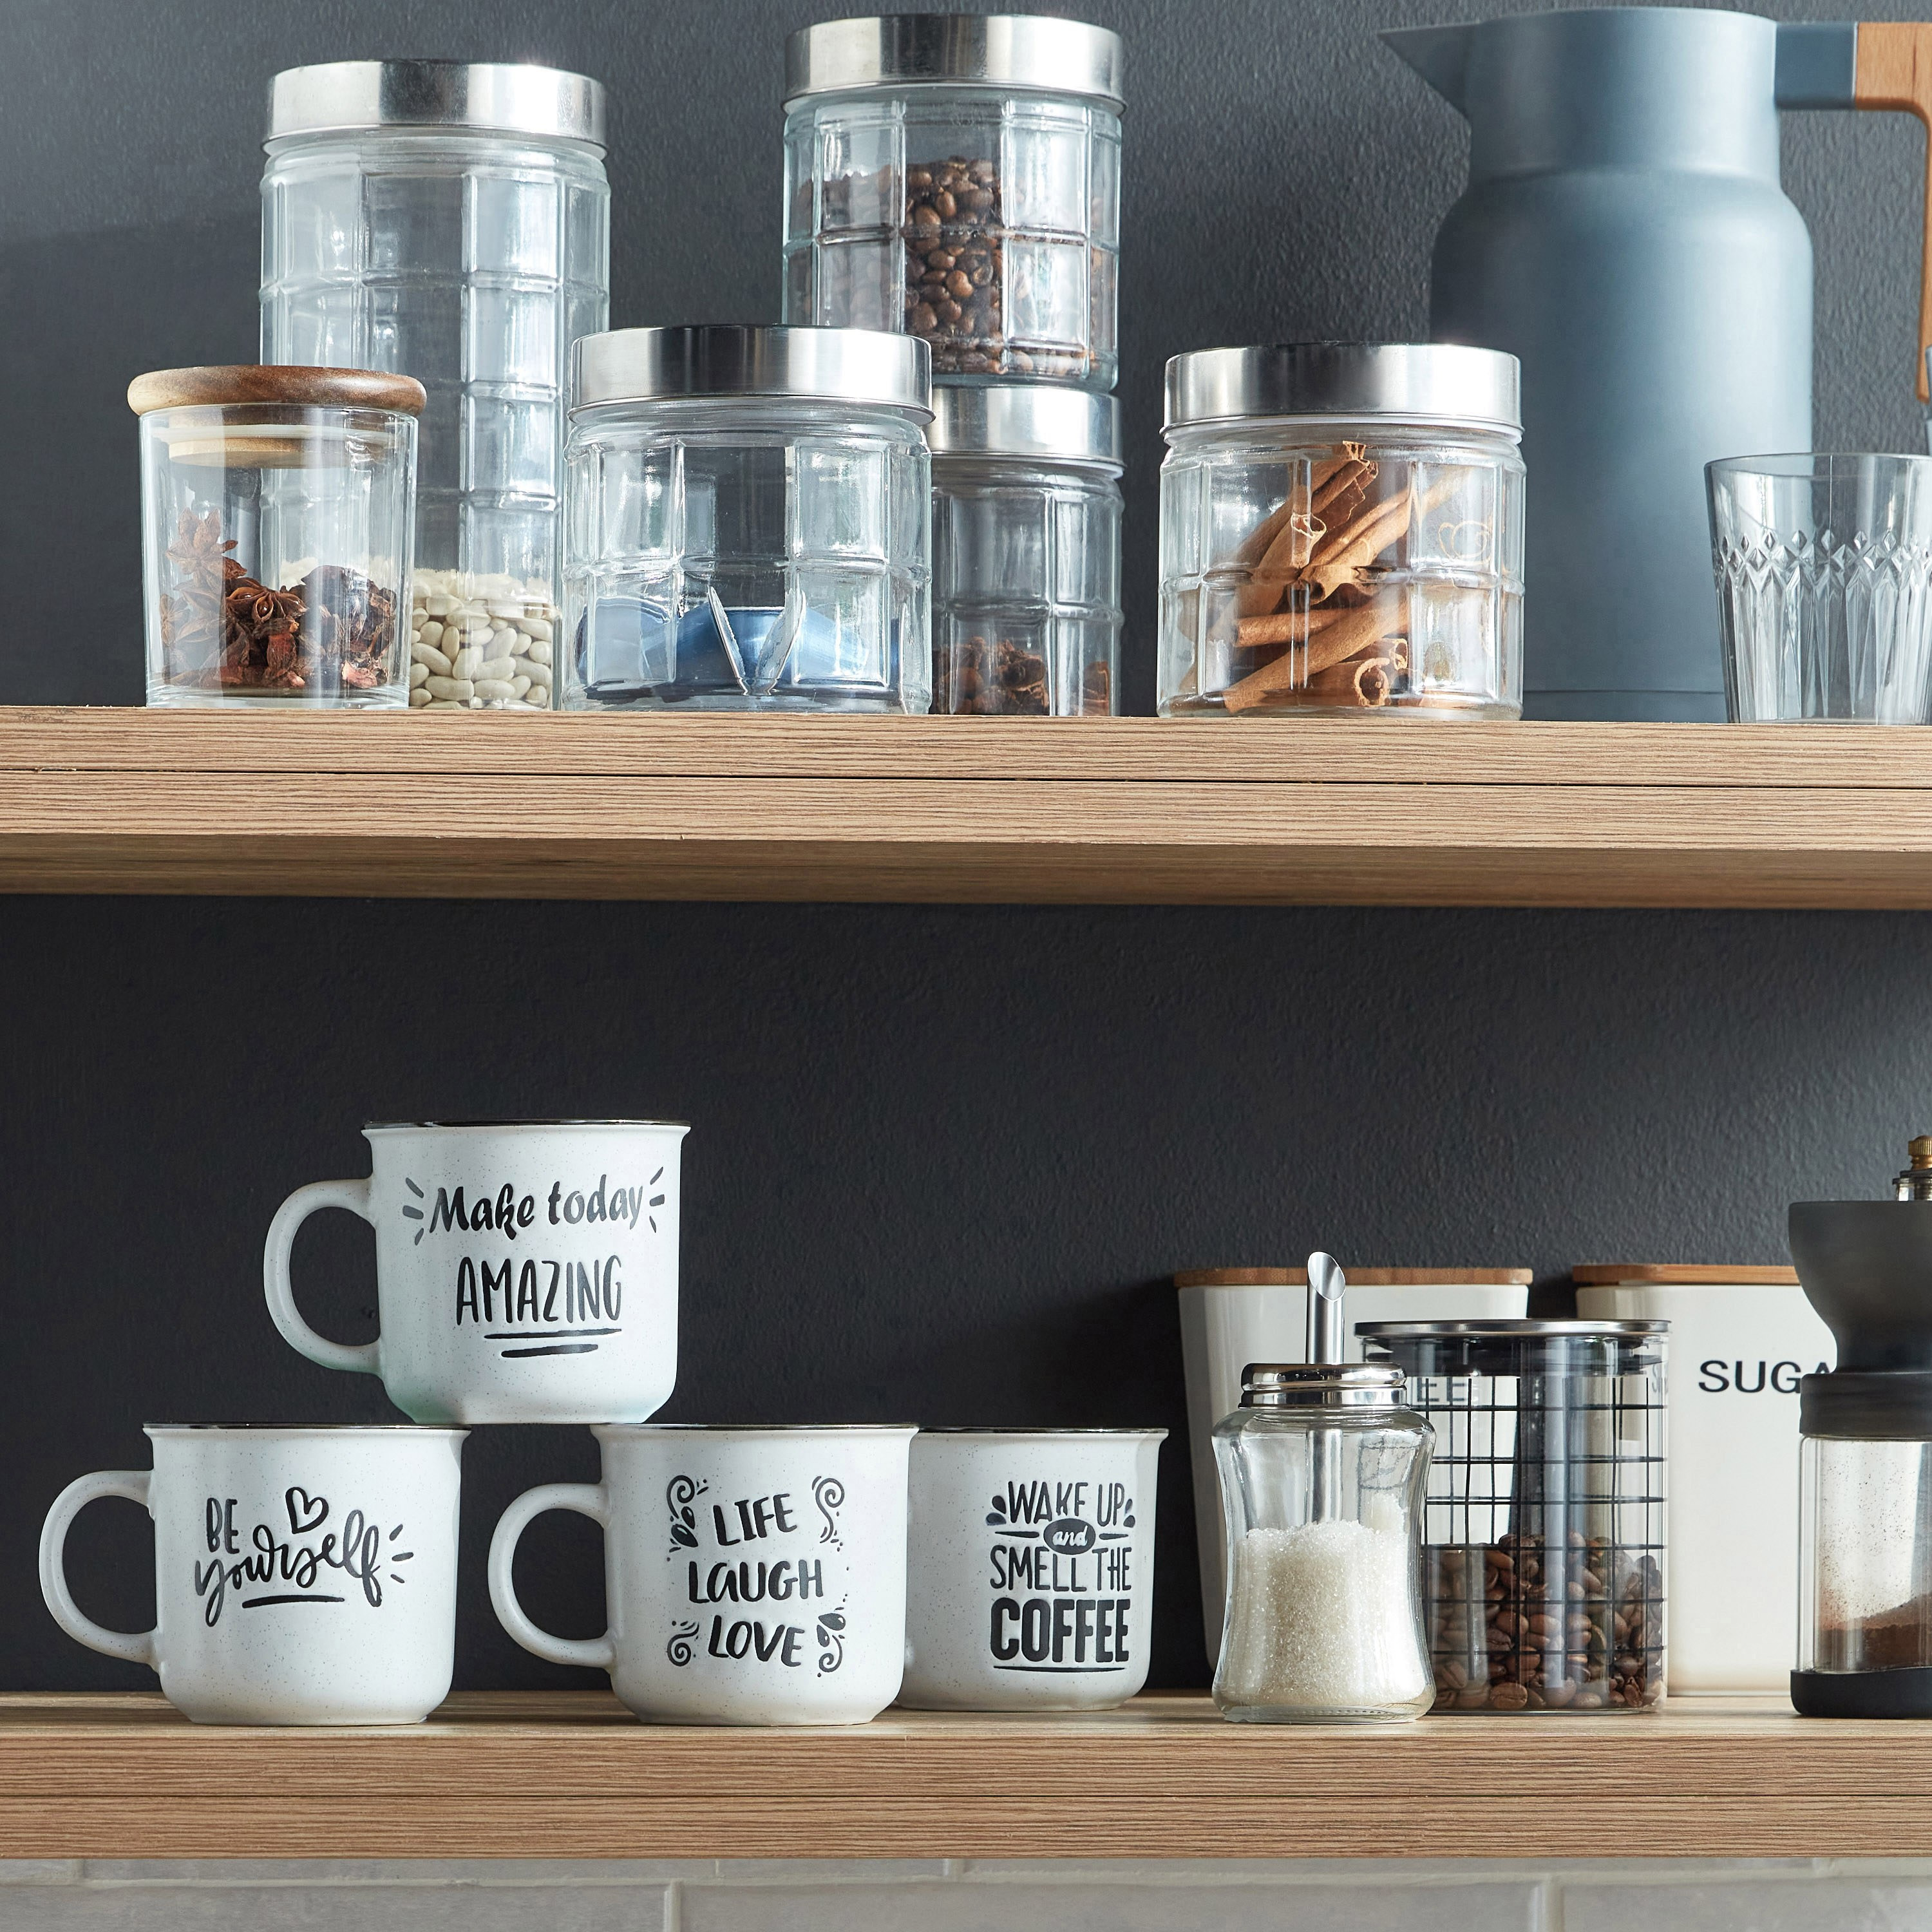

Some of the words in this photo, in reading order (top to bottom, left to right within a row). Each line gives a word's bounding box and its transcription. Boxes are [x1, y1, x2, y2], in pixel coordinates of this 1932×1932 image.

[430, 1183, 535, 1240] Make
[548, 1174, 643, 1229] today
[456, 1255, 621, 1325] AMAZING
[206, 1497, 240, 1554] BE
[713, 1493, 797, 1546] LIFE
[1008, 1481, 1089, 1524] WAKE
[1097, 1482, 1126, 1527] UP
[1052, 1524, 1088, 1547] and
[194, 1509, 383, 1627] yourself
[990, 1544, 1087, 1592] SMELL
[1092, 1546, 1132, 1592] THE
[708, 1615, 805, 1667] LOVE
[990, 1597, 1131, 1663] COFFEE
